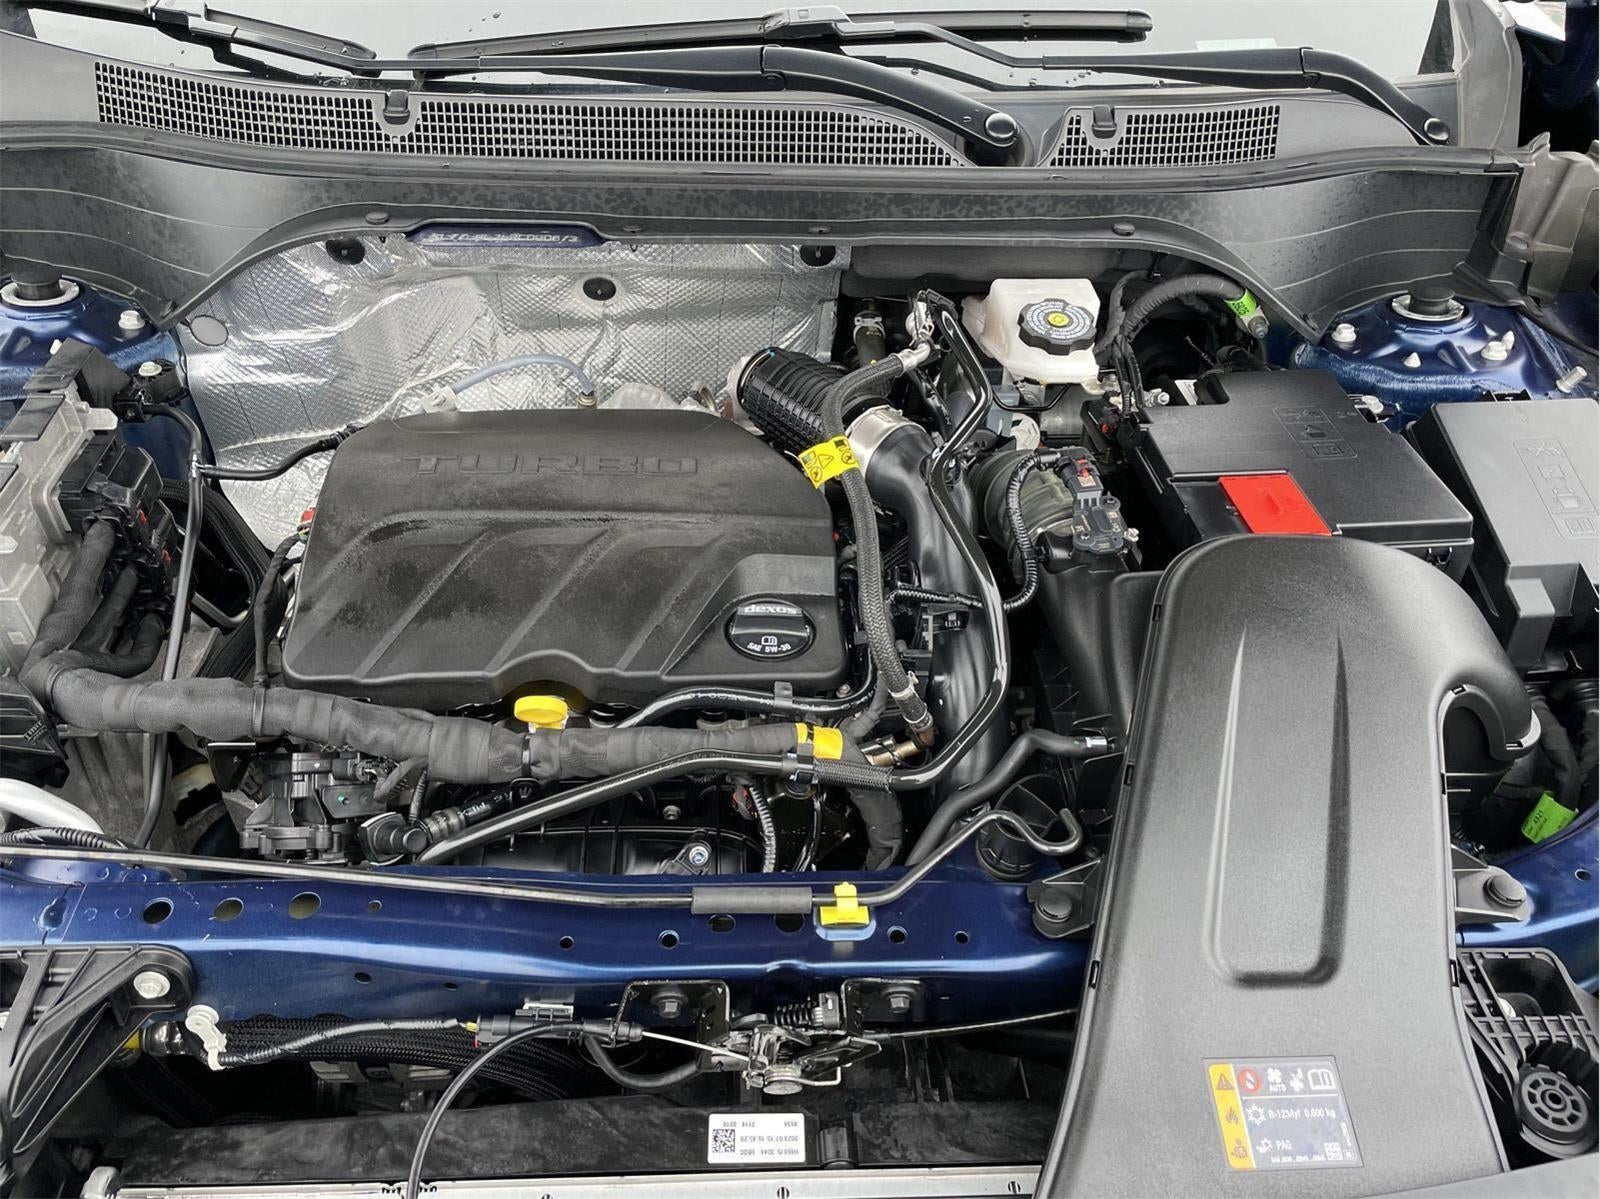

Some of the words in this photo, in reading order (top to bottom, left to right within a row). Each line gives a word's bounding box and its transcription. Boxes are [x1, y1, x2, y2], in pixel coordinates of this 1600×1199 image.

[401, 454, 698, 476] TURBO
[744, 604, 797, 614] dexos
[747, 642, 762, 651] SAE
[1269, 1084, 1286, 1092] AUTO
[1276, 1140, 1292, 1150] PAG
